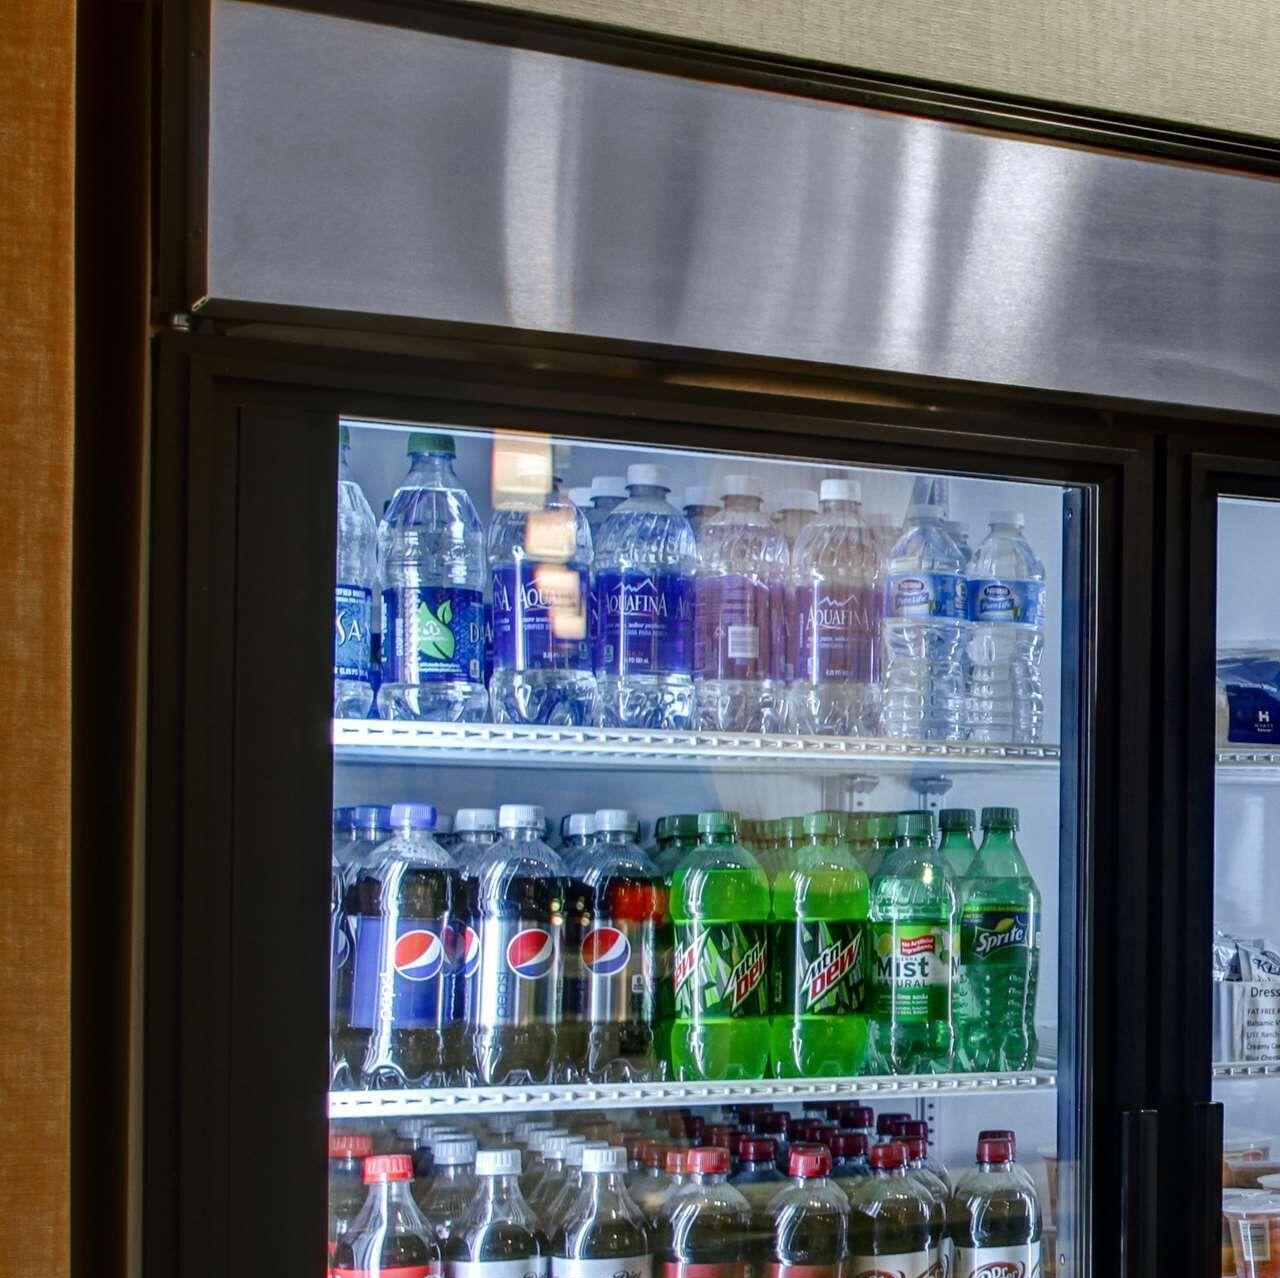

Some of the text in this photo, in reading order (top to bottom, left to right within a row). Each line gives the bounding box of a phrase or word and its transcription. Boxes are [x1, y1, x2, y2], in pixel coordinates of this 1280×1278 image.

[975, 927, 1024, 953] Sprite
[877, 956, 929, 978] Mist
[992, 1266, 1009, 1278] Dr
